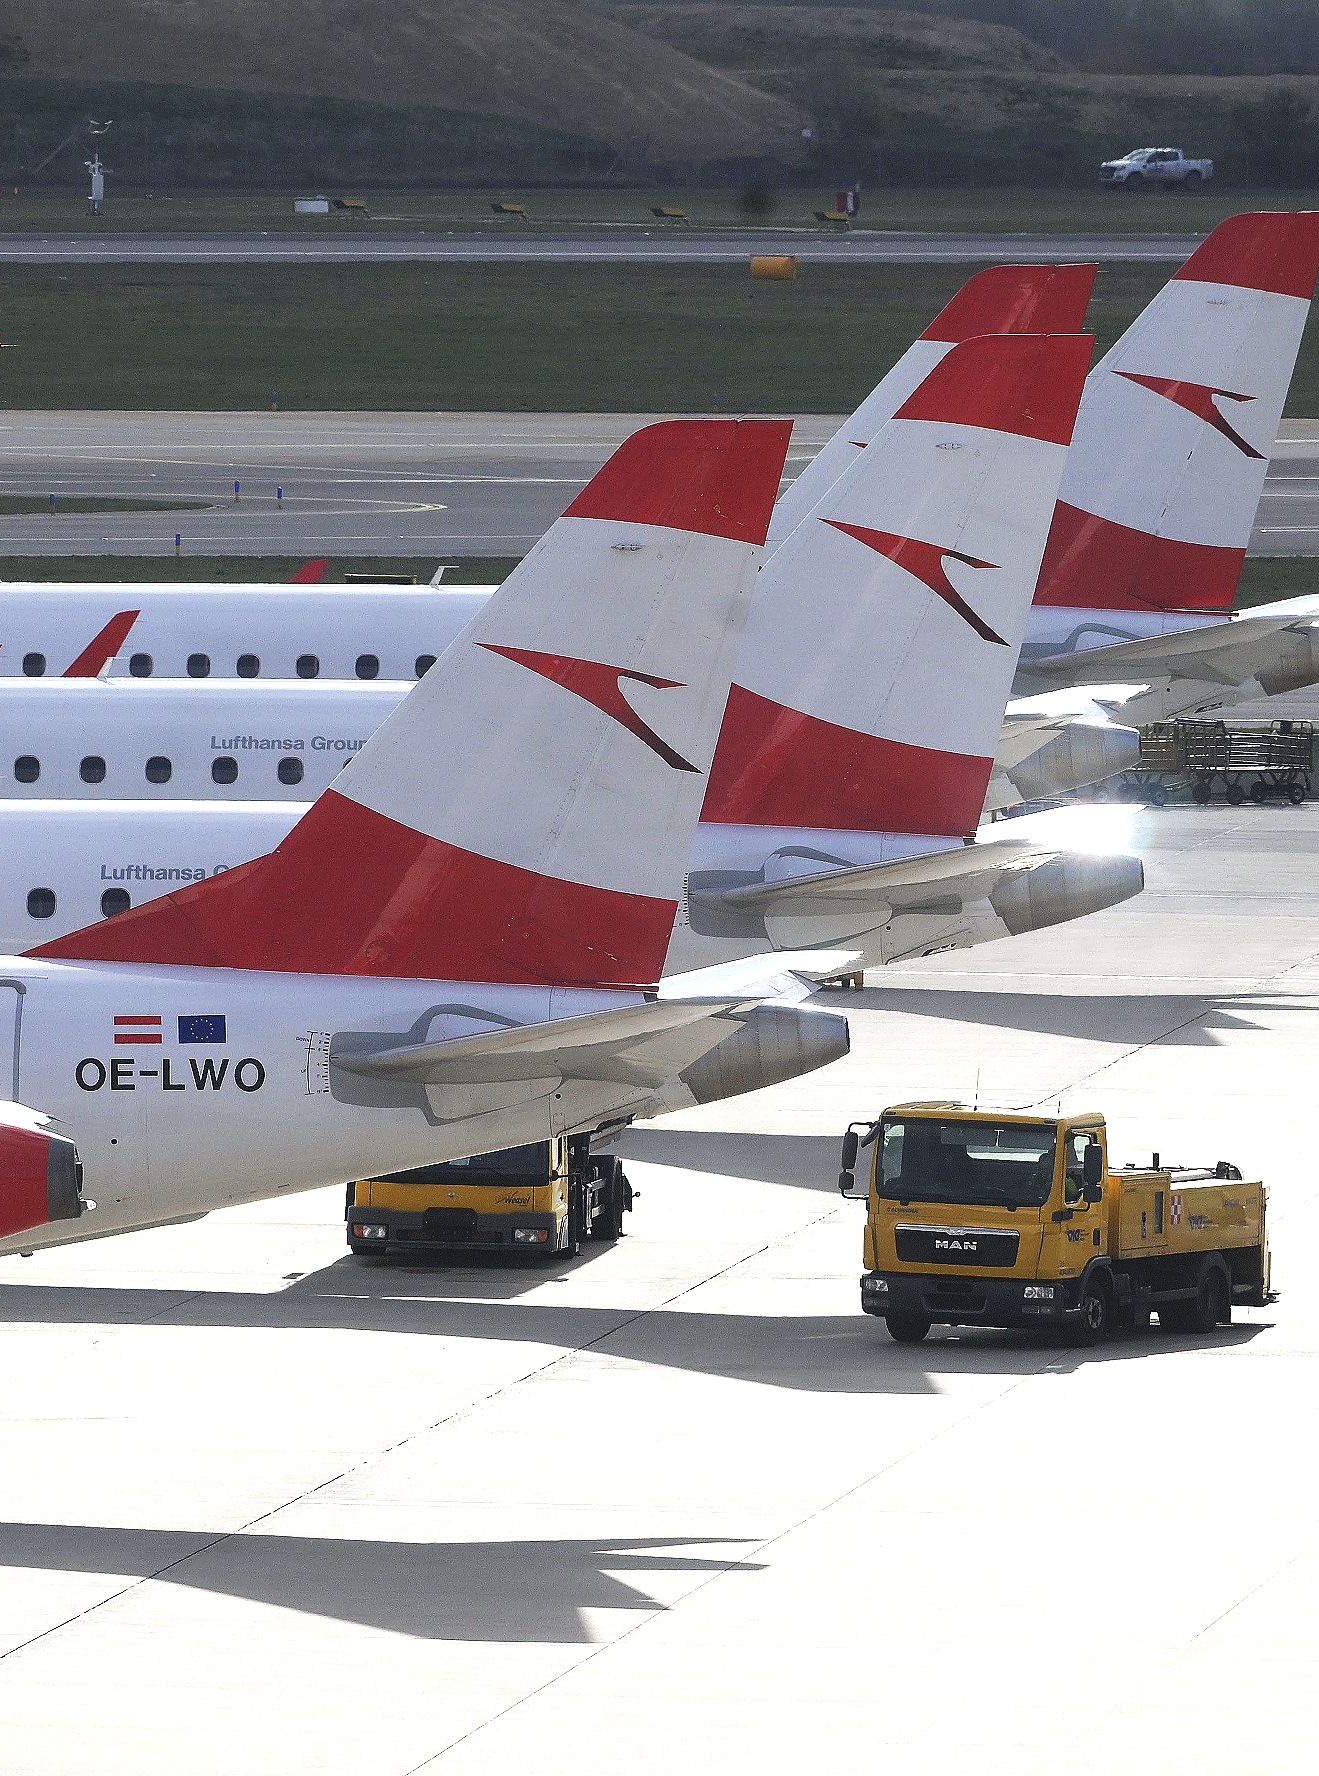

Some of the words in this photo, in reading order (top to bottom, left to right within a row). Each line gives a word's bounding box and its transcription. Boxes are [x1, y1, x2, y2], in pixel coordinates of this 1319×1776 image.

[210, 735, 305, 750] Lufthansa
[100, 864, 206, 881] Lufthansa
[75, 1057, 266, 1092] OE-LWO
[935, 1239, 978, 1251] MAN
